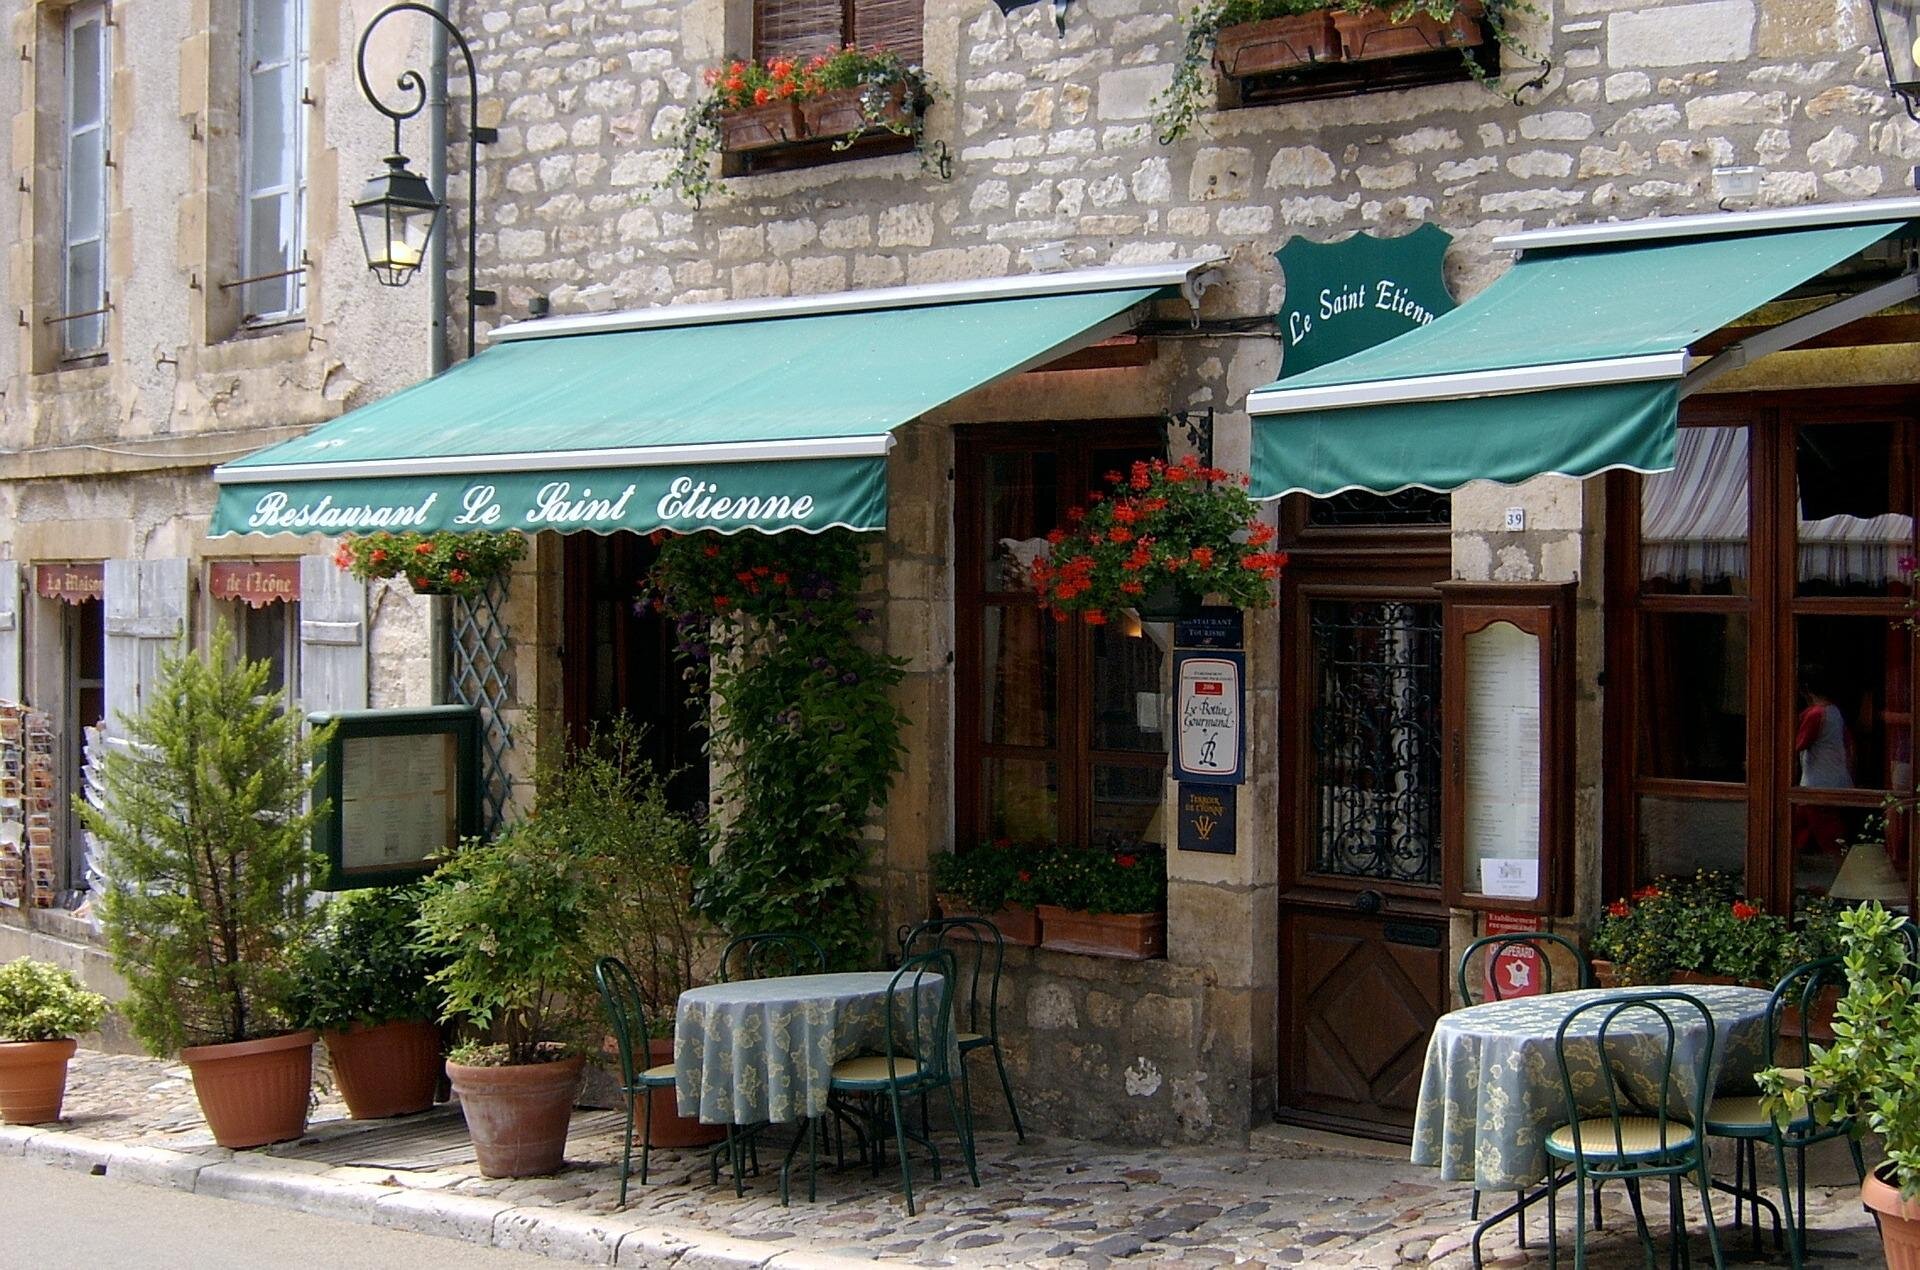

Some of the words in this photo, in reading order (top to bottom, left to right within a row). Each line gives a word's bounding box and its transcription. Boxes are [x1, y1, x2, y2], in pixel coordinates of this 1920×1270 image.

[1289, 311, 1312, 346] Le
[1319, 284, 1365, 320] Saint
[1375, 280, 1434, 325] Etienn
[249, 491, 438, 527] Restaurant
[454, 485, 501, 525] Le
[526, 482, 636, 523] Saint
[656, 476, 814, 519] Etienne
[1507, 513, 1522, 525] 39
[47, 573, 61, 590] La
[227, 573, 240, 591] de
